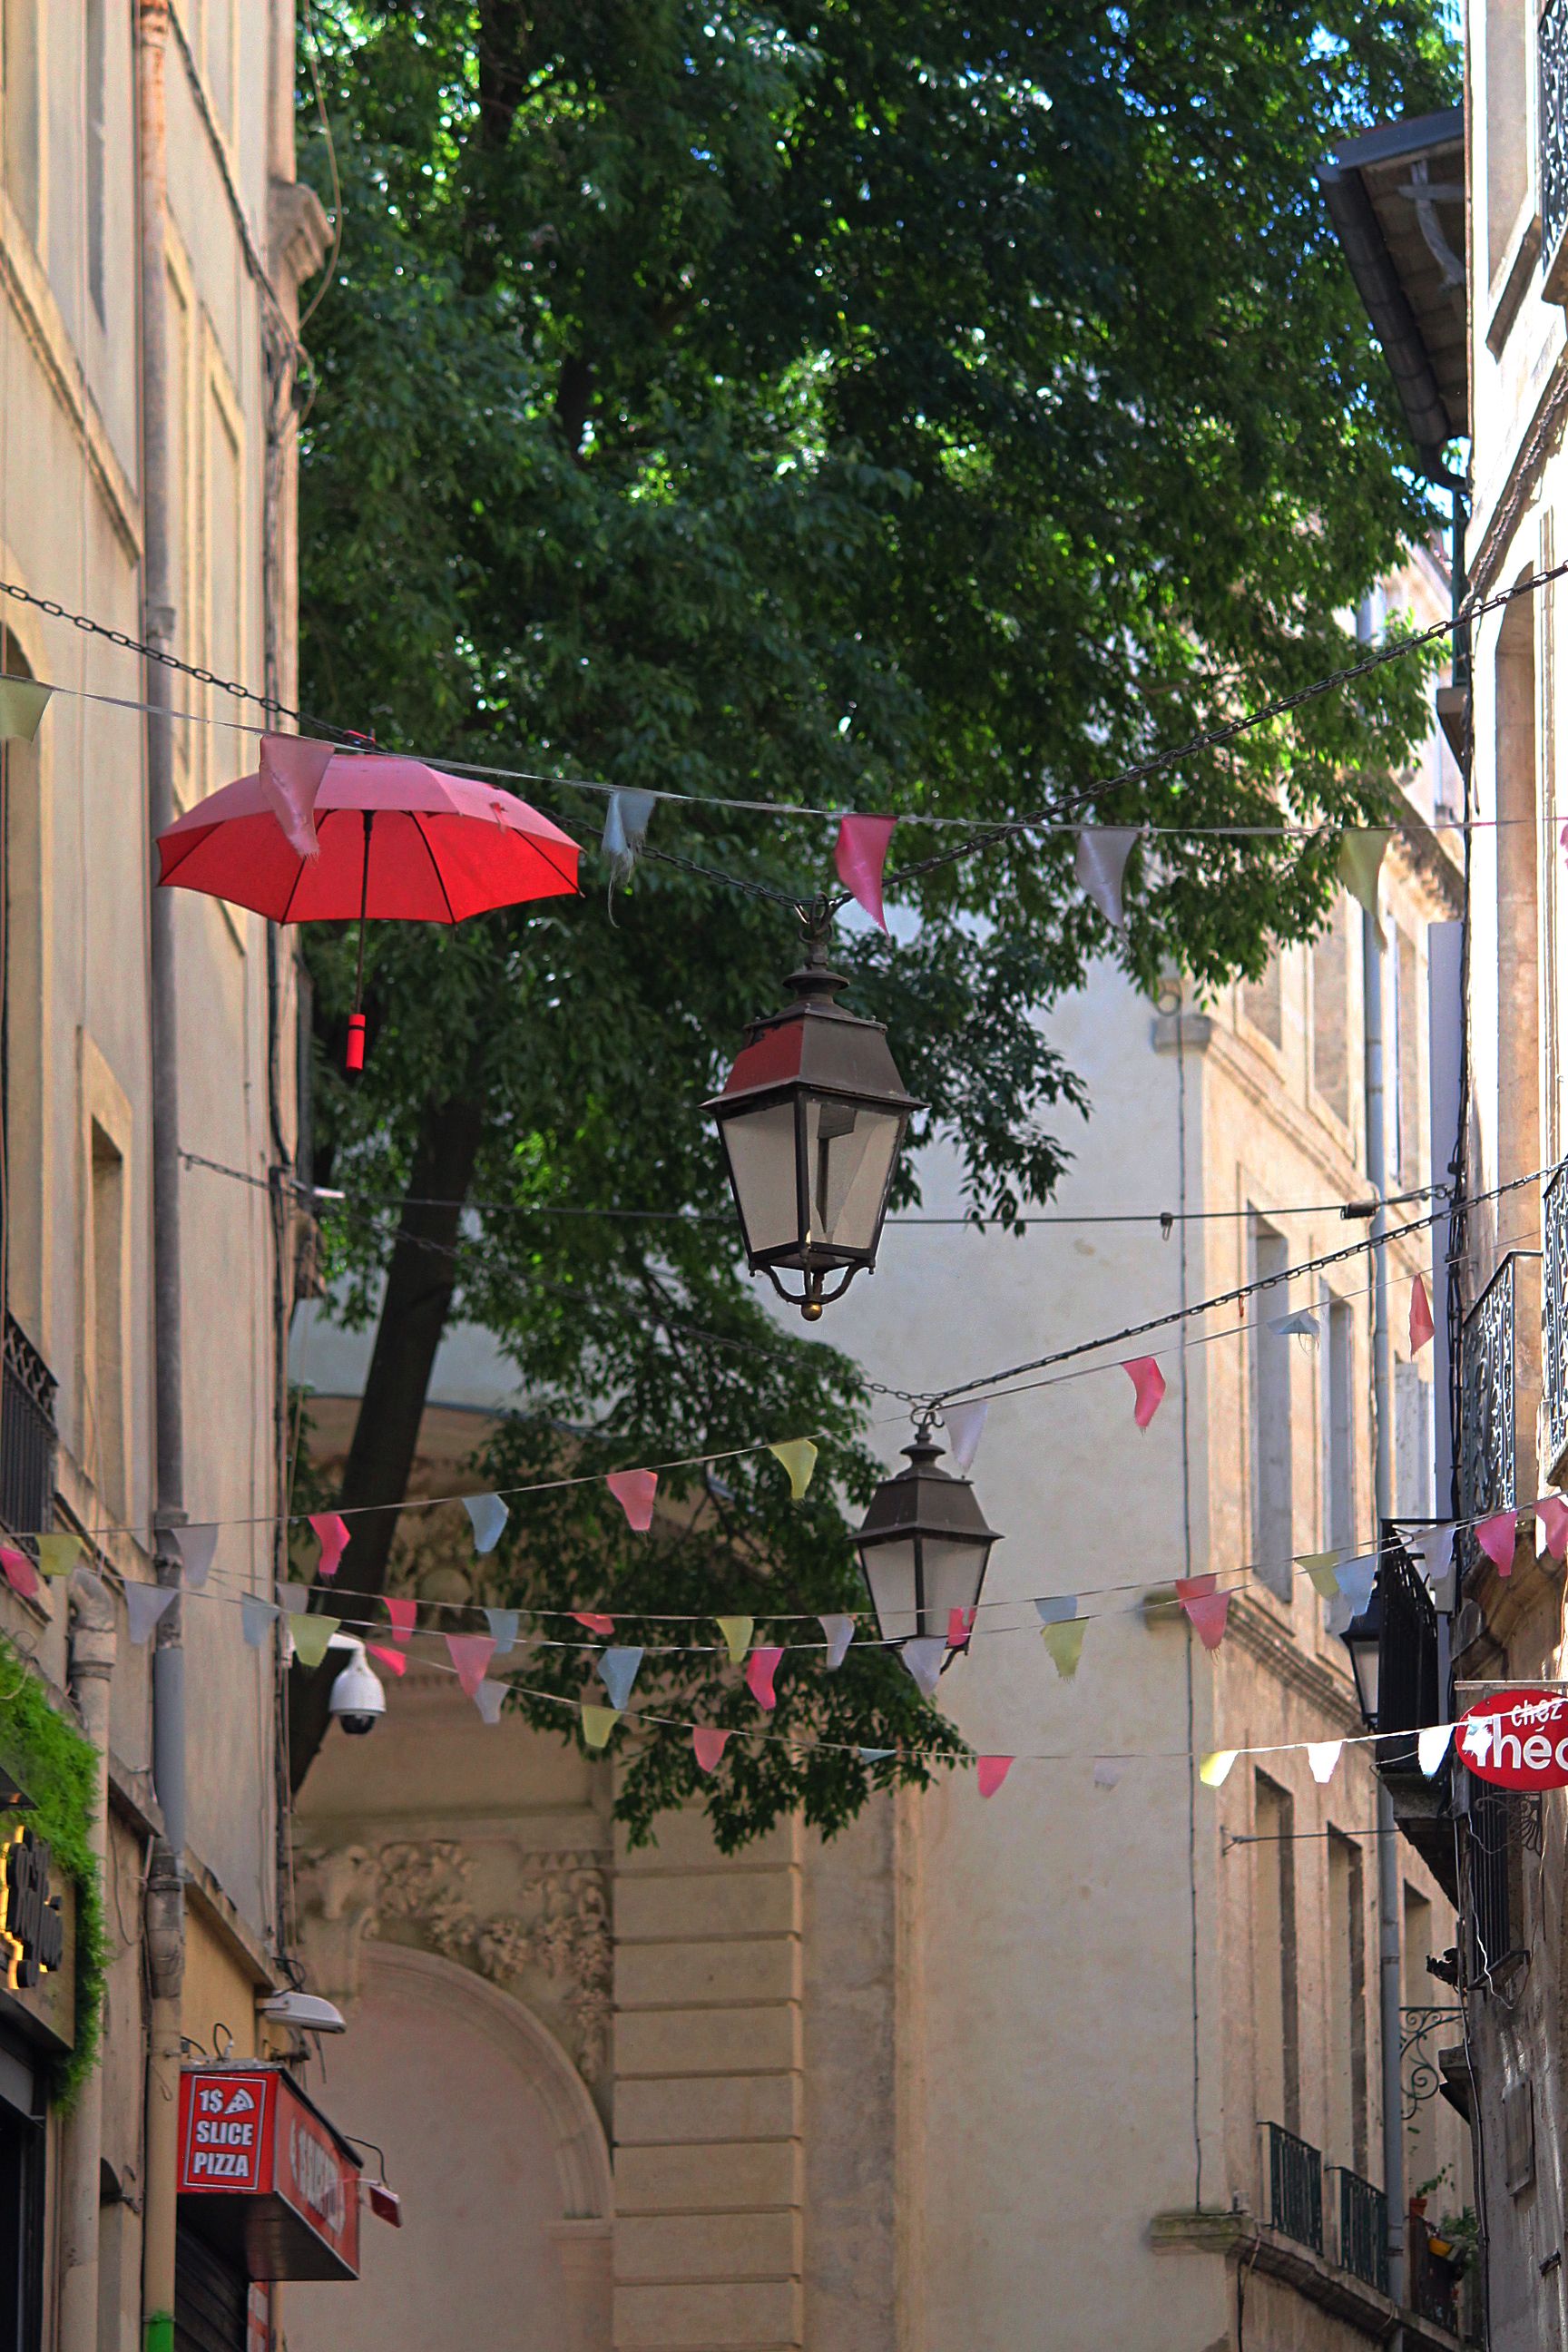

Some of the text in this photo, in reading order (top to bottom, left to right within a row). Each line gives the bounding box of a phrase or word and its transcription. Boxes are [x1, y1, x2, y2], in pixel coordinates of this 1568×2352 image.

[199, 2088, 224, 2113] 1$
[196, 2120, 254, 2146] SLICE
[192, 2151, 250, 2178] PIZZA
